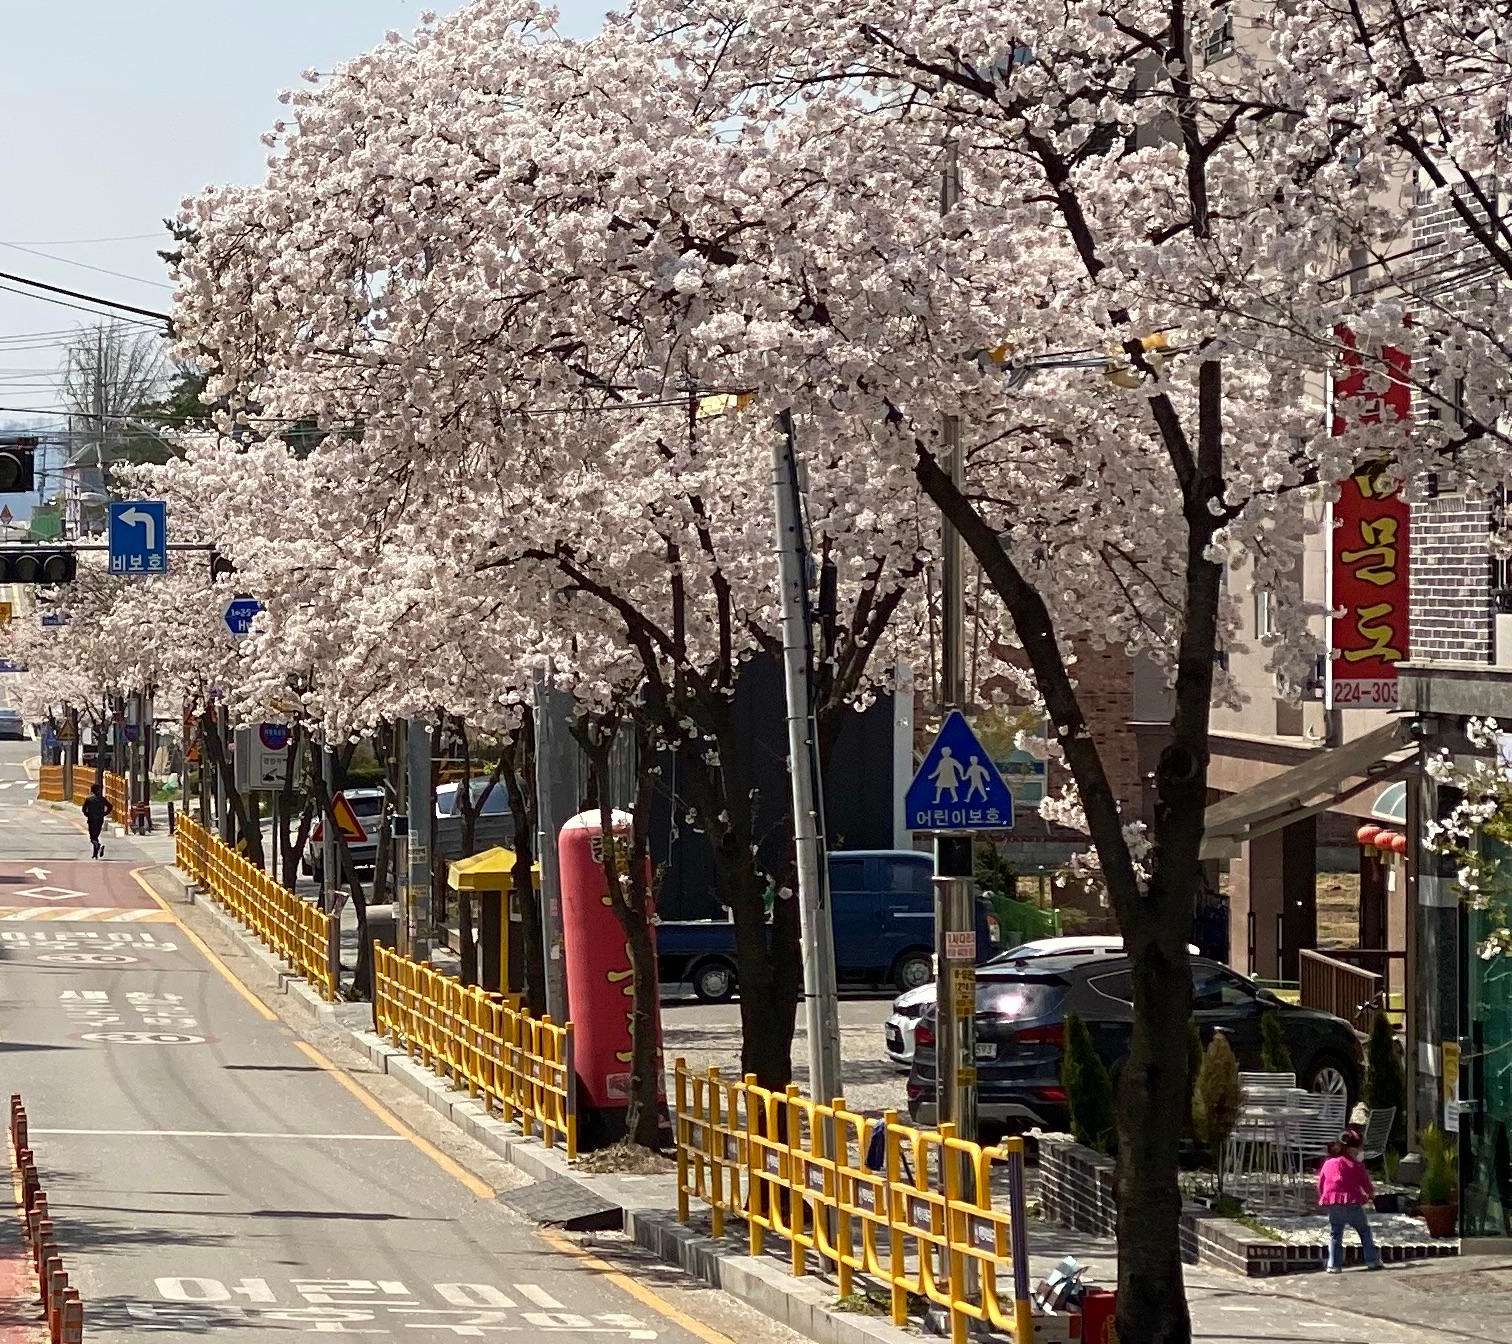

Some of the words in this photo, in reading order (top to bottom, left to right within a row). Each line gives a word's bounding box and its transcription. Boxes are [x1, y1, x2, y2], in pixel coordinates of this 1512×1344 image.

[112, 553, 163, 571] 비보호
[916, 807, 1001, 826] 어린이보호
[154, 1276, 566, 1309] 어린이
[125, 1303, 658, 1340] 보호구역
